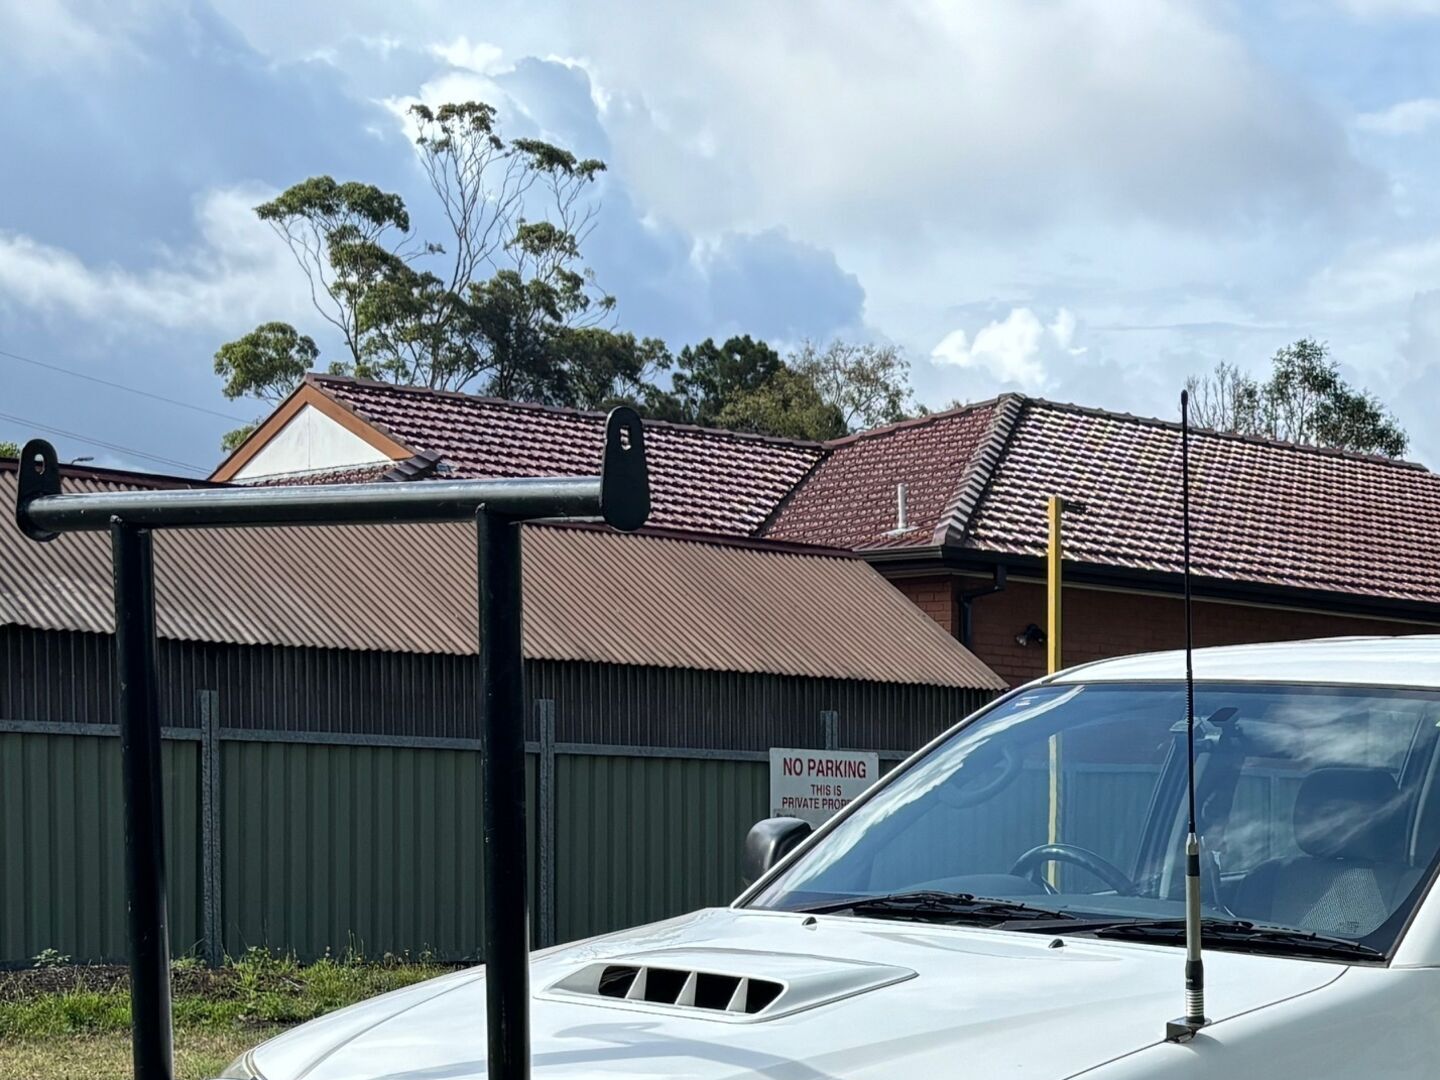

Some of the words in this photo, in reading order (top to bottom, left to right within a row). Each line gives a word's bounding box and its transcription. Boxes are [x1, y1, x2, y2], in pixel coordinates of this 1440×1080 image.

[783, 757, 803, 776] NO
[807, 759, 867, 779] PARKING
[811, 784, 831, 796] THIS
[833, 785, 842, 796] IS
[782, 797, 820, 810] PRIVATE
[822, 799, 850, 810] PROP
